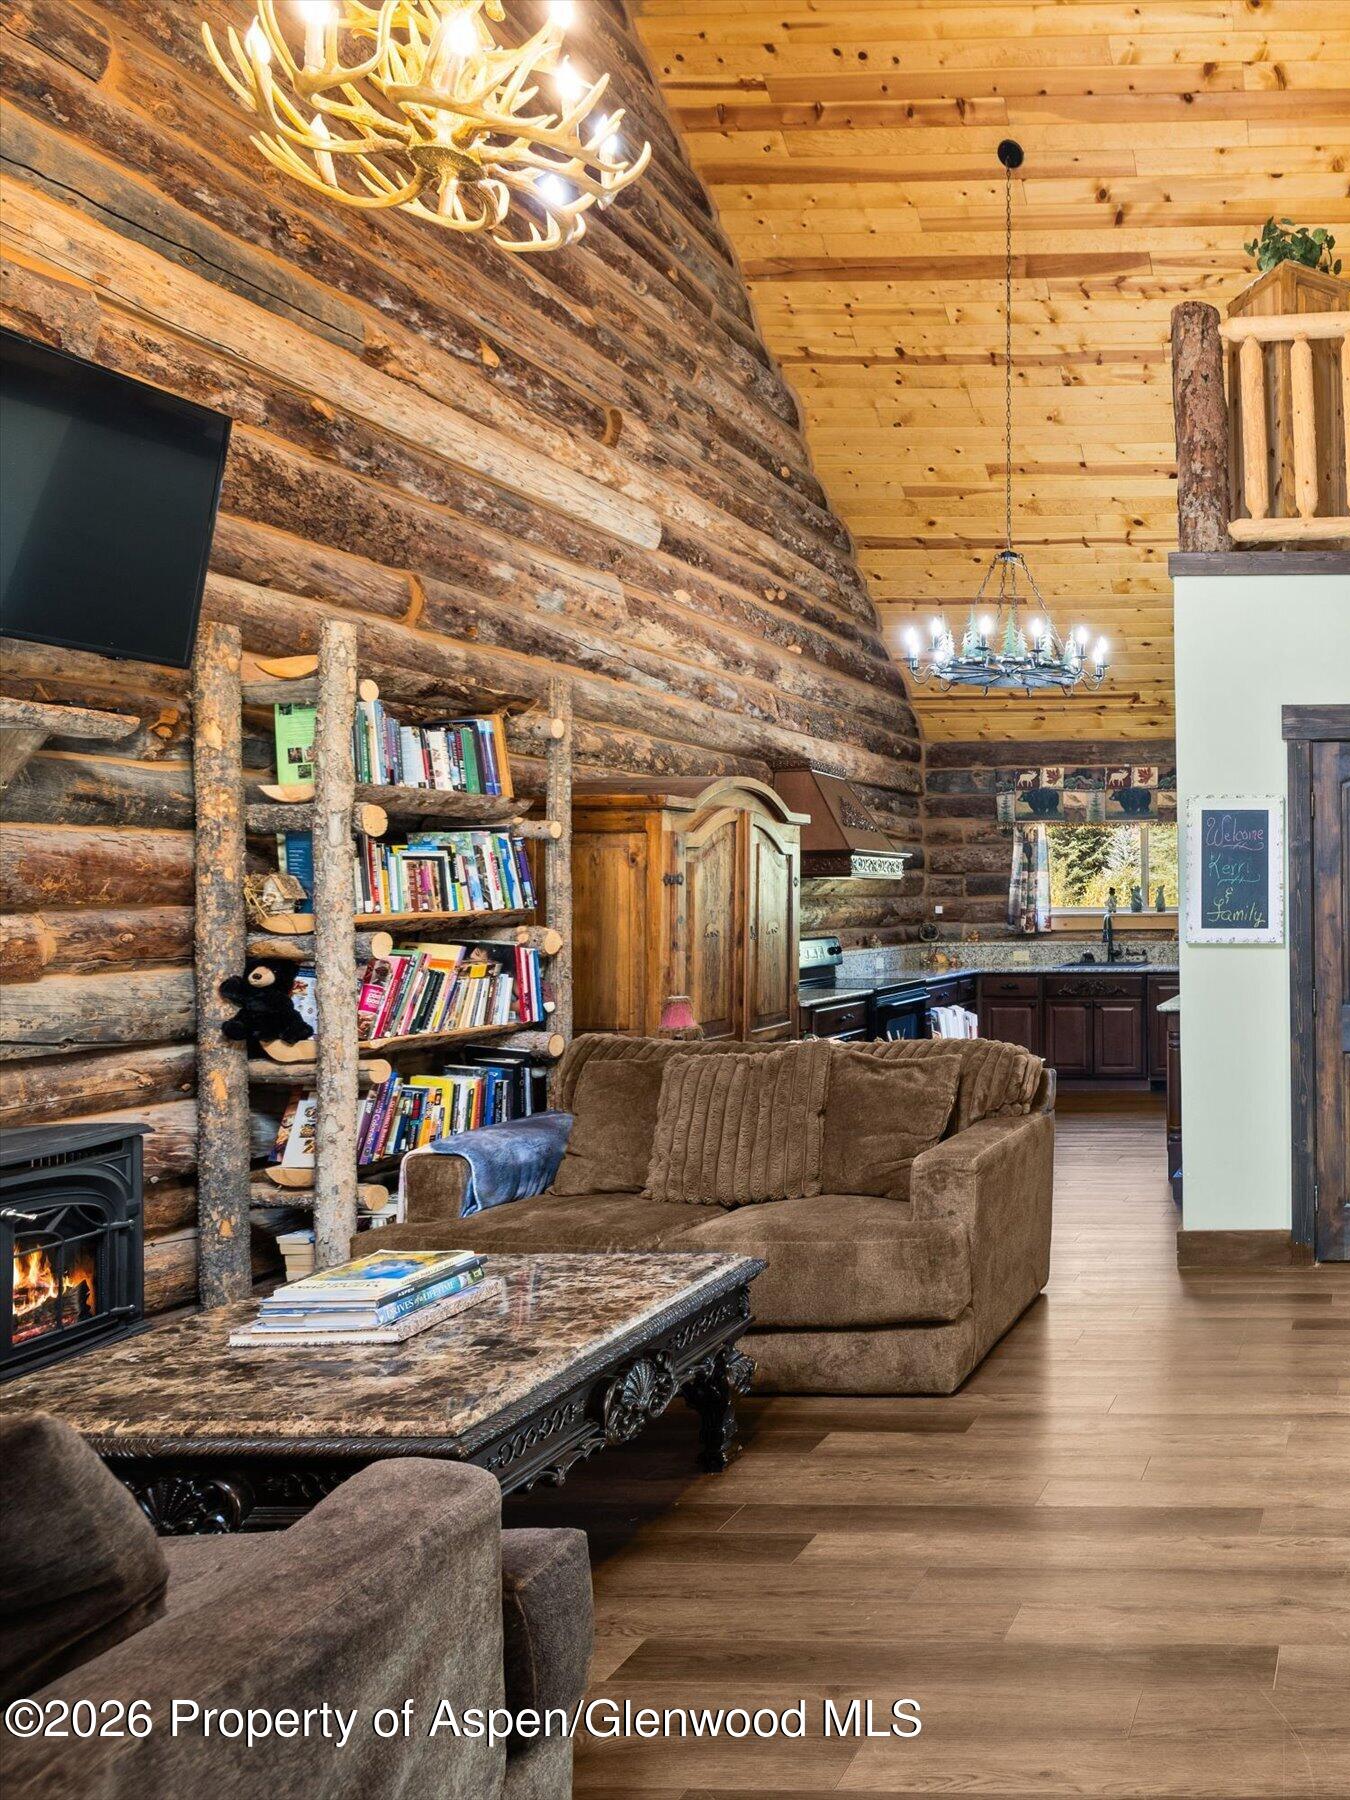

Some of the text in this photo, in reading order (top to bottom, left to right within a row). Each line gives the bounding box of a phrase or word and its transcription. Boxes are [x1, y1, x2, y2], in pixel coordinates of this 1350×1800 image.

[1206, 815, 1264, 848] Welcome
[1206, 897, 1266, 928] Family
[397, 1287, 415, 1298] ASPEN
